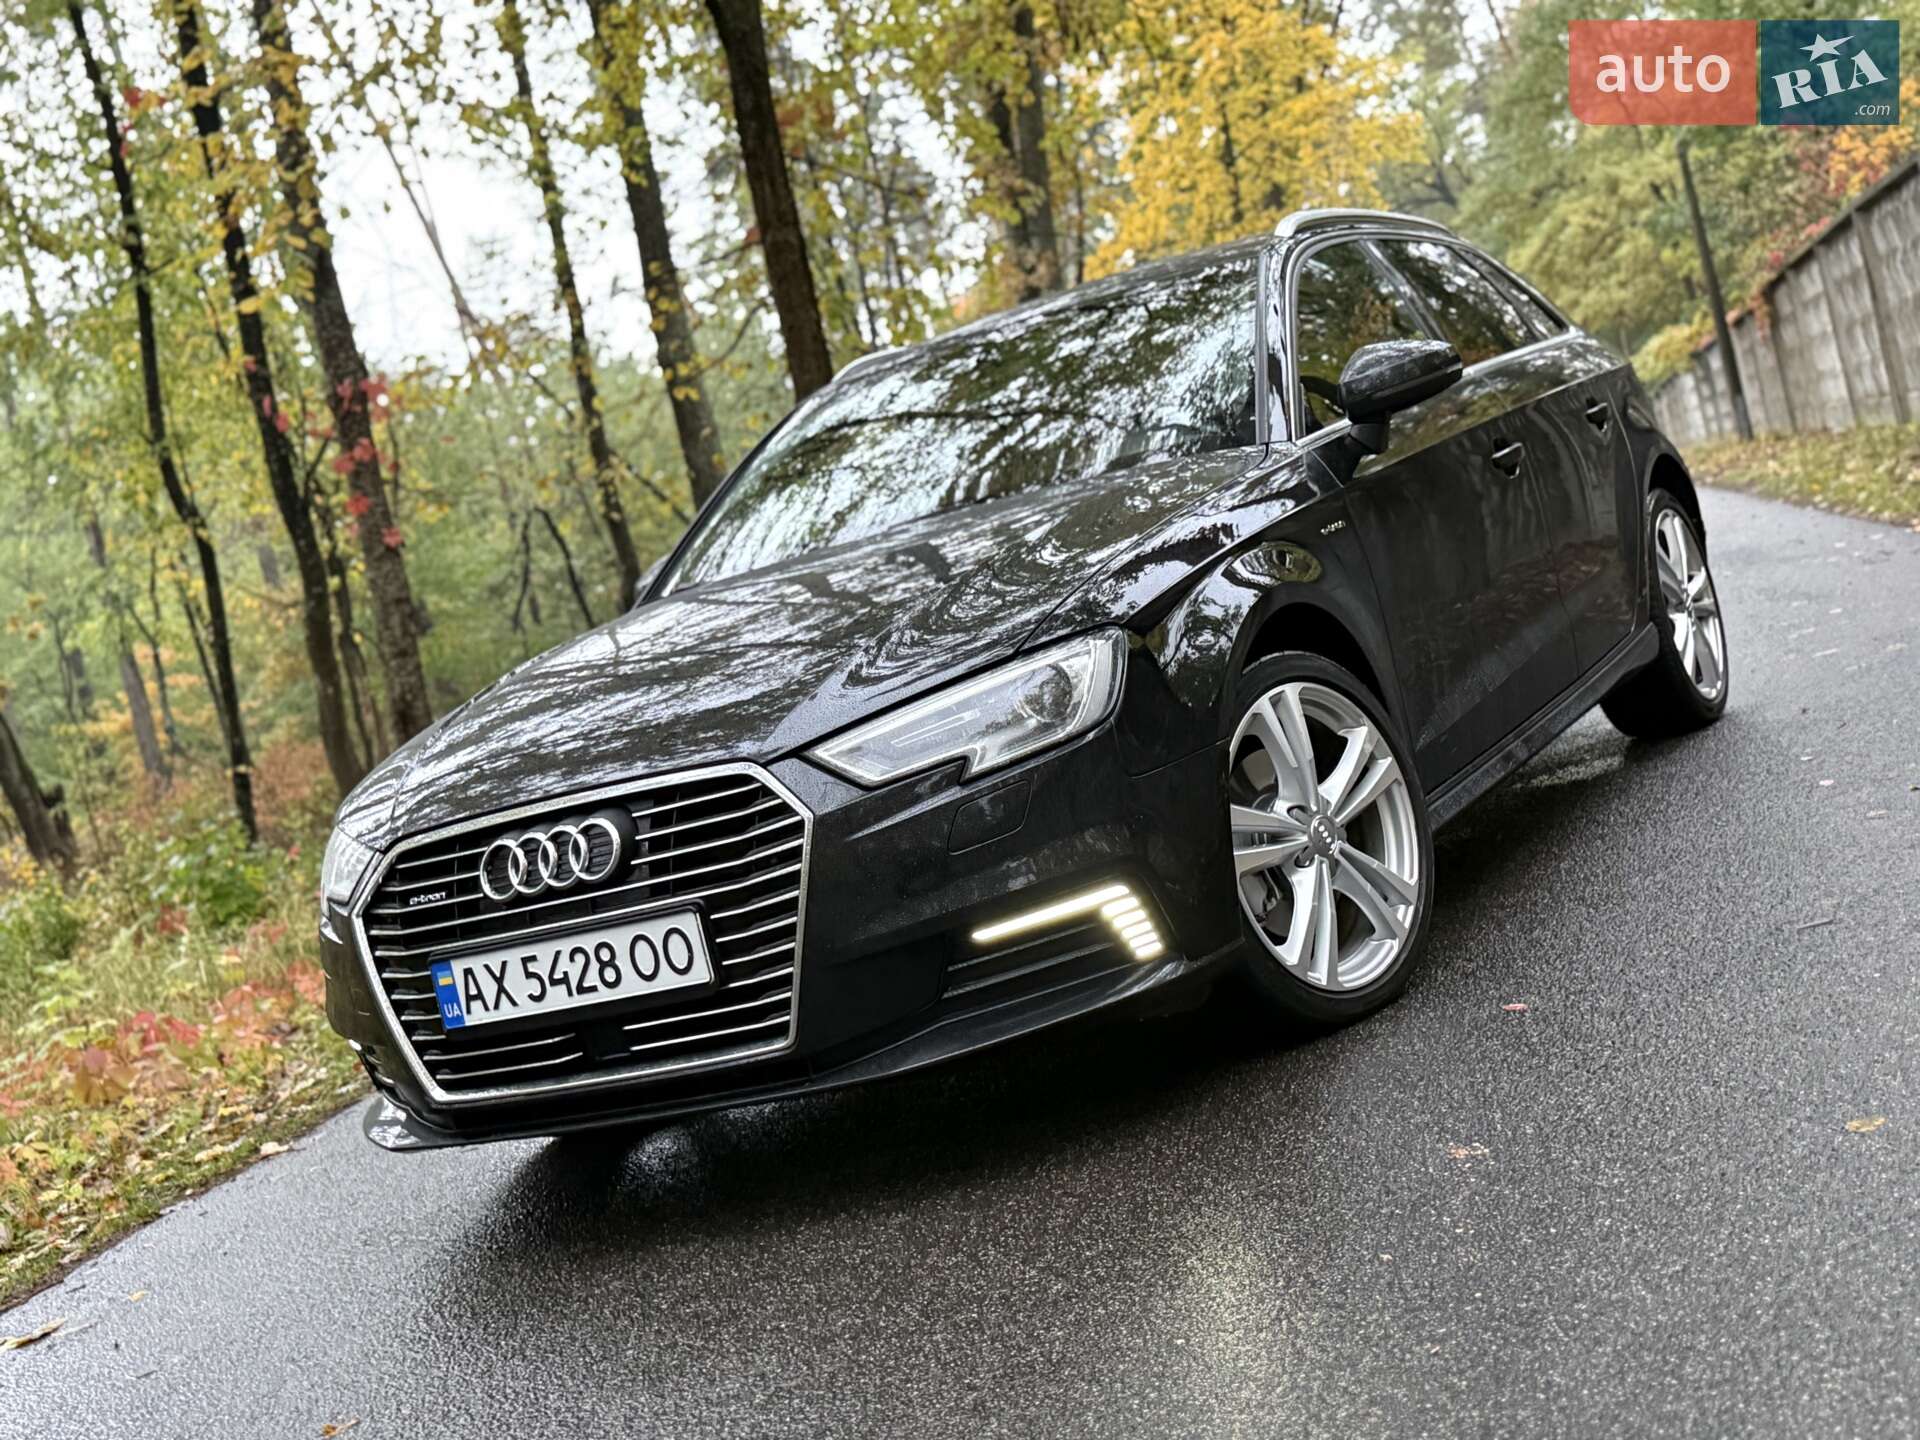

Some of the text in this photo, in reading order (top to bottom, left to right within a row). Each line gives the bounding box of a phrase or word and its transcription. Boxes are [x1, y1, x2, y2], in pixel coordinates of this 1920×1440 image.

[462, 927, 694, 1015] AX 5428 OO
[443, 1002, 462, 1018] UA
